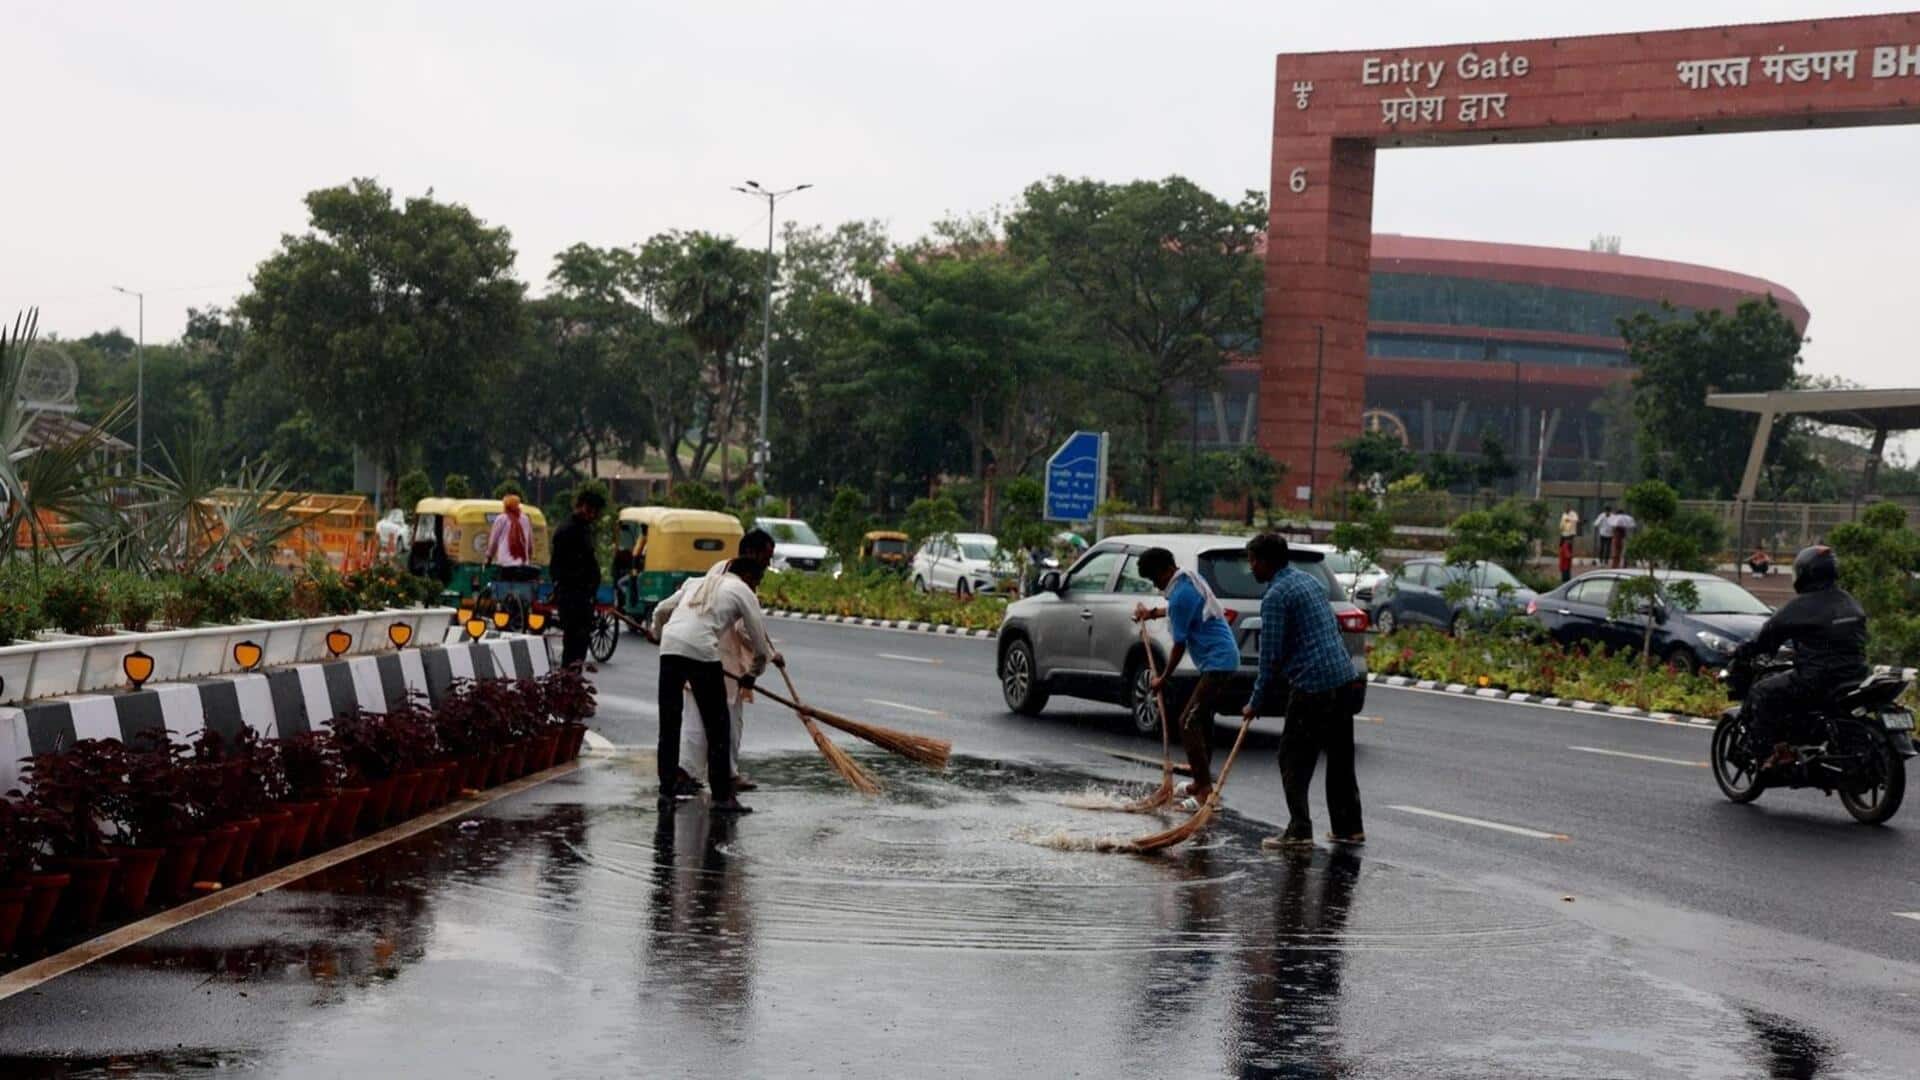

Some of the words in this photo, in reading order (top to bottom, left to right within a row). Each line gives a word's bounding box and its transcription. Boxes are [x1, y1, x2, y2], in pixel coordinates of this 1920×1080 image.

[1361, 57, 1444, 88] Entry
[1457, 53, 1529, 79] Gate
[1676, 57, 1750, 88] भारत
[1760, 45, 1857, 84] मंडपम
[1381, 89, 1445, 124] प्रवेश
[1457, 93, 1507, 123] द्वार
[1289, 167, 1306, 193] 6
